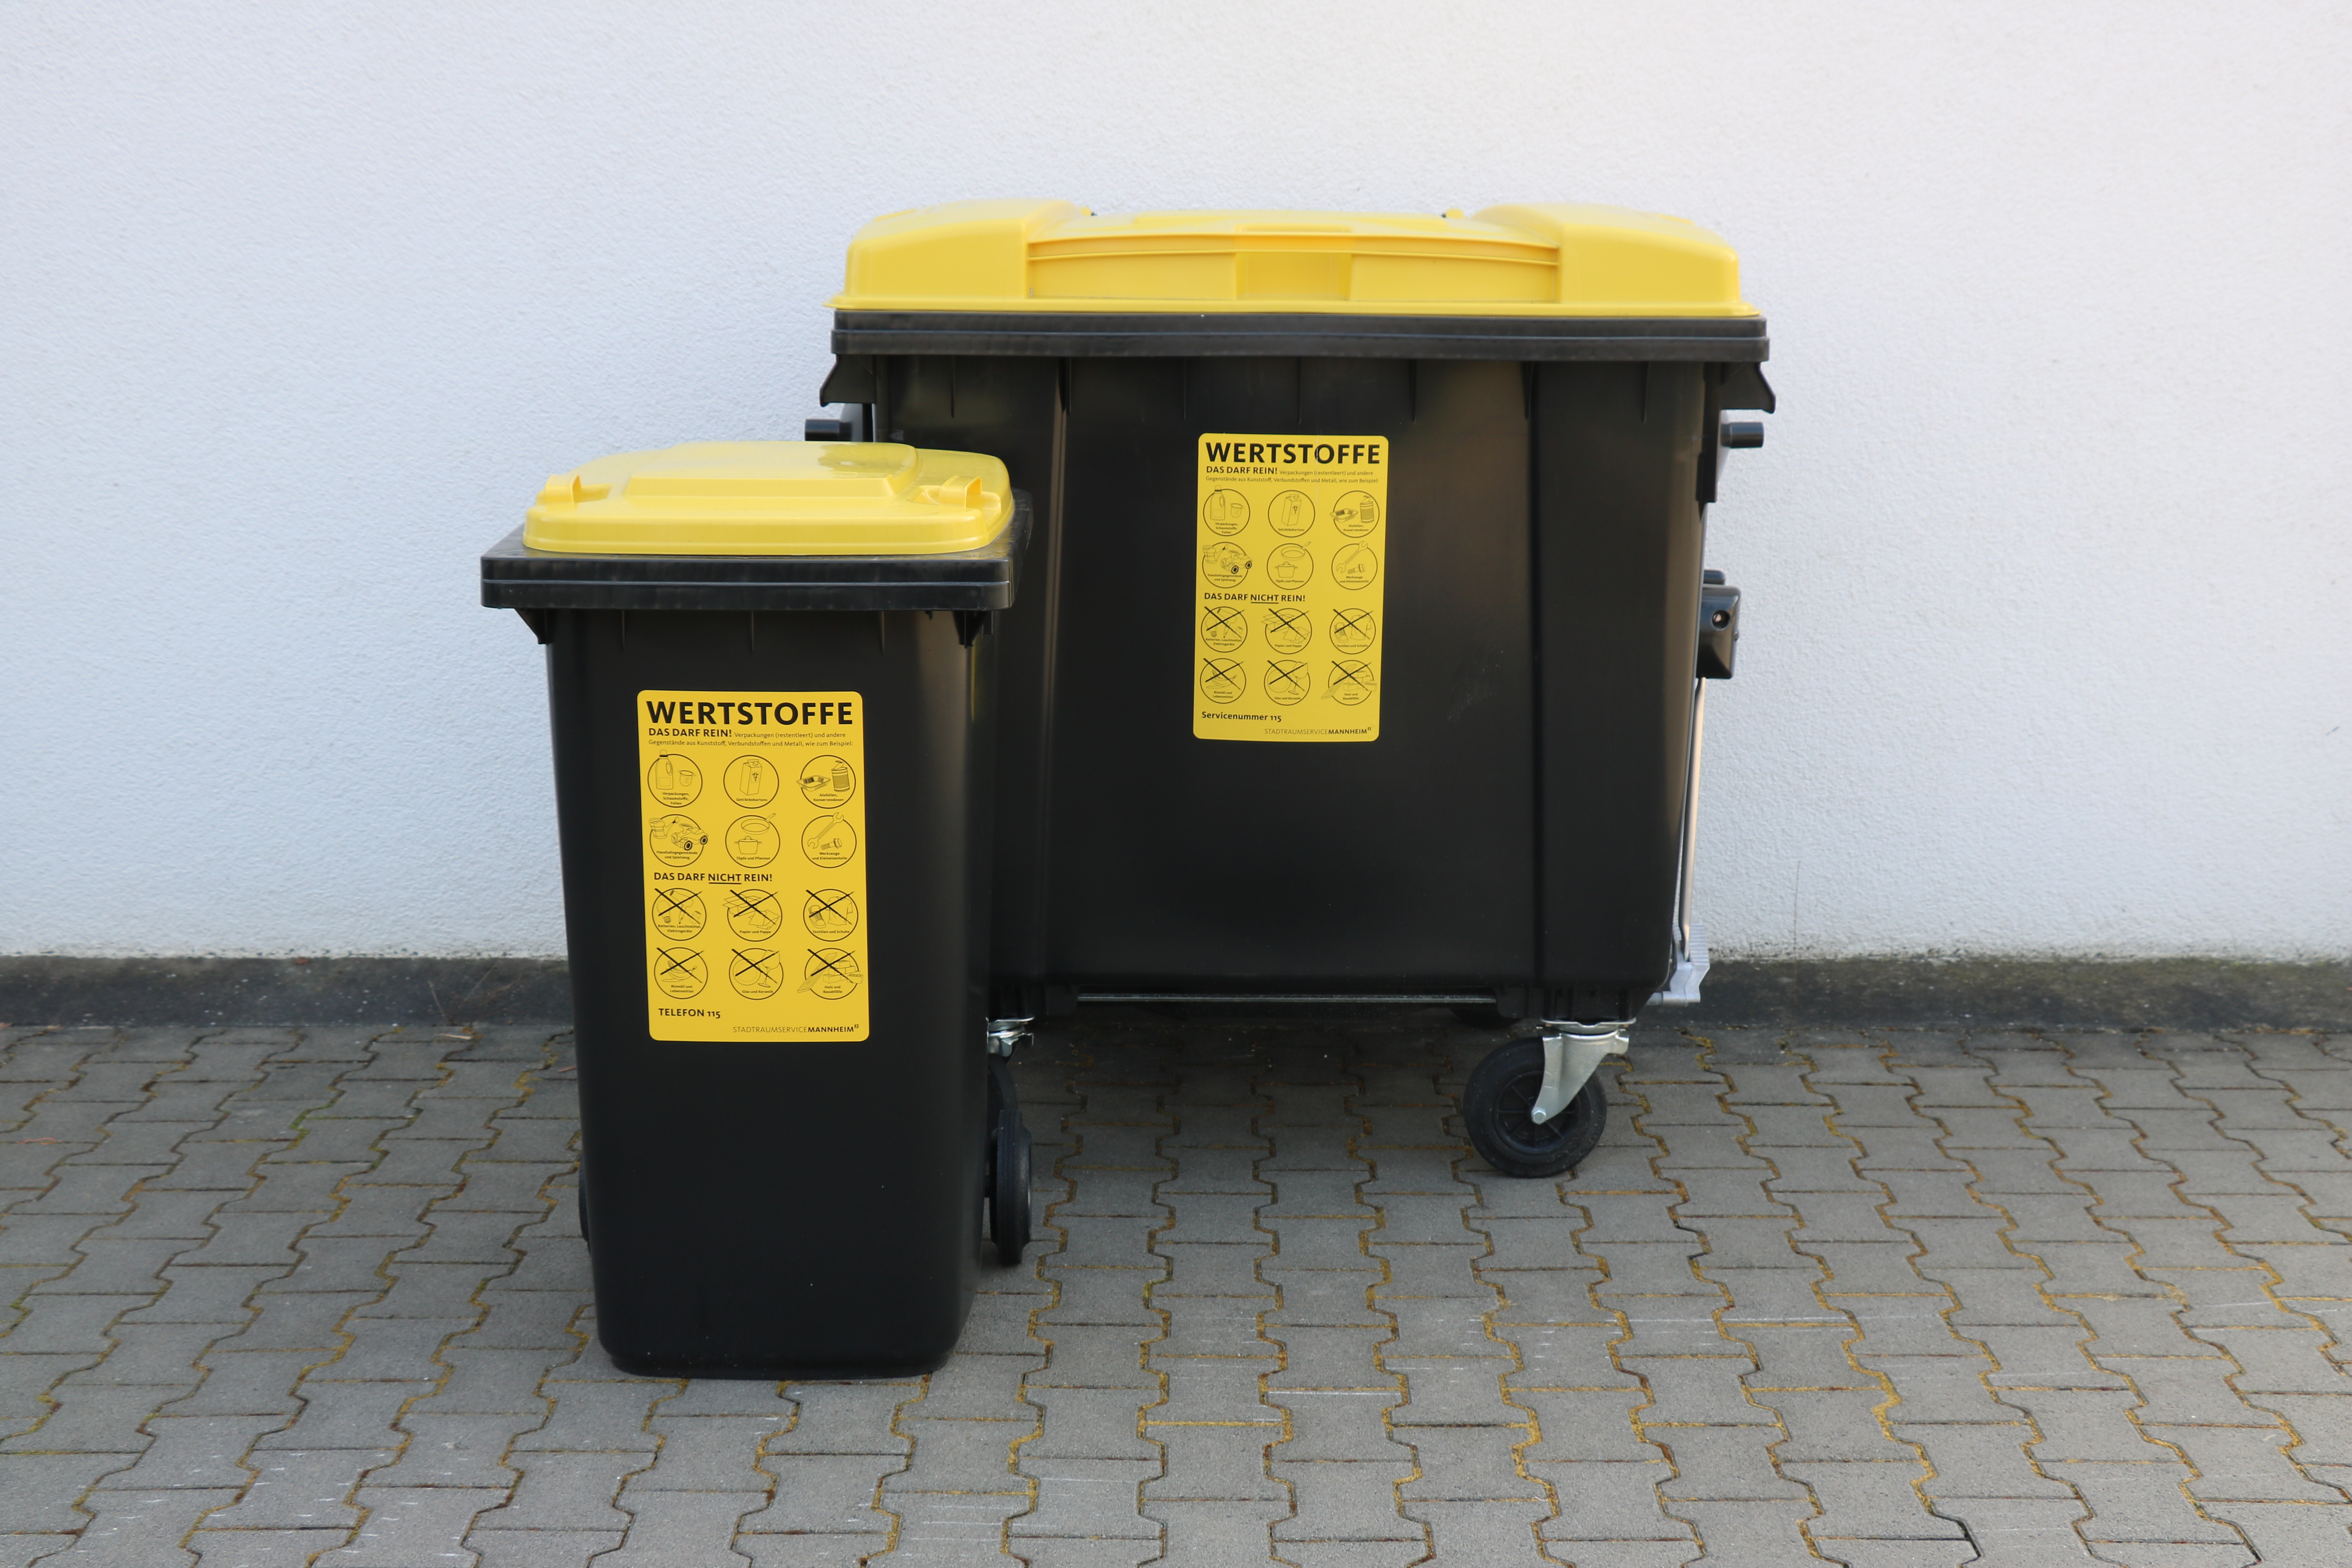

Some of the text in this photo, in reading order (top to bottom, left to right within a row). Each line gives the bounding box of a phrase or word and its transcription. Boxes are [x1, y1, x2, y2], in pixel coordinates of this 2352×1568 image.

[1206, 442, 1380, 464] WERTSTOFFE
[646, 701, 853, 724] WERTSTOFFE
[1202, 711, 1268, 720] Servicenummer
[673, 728, 701, 737] DARF
[703, 729, 731, 737] REIN!
[659, 1008, 704, 1017] TELEFON
